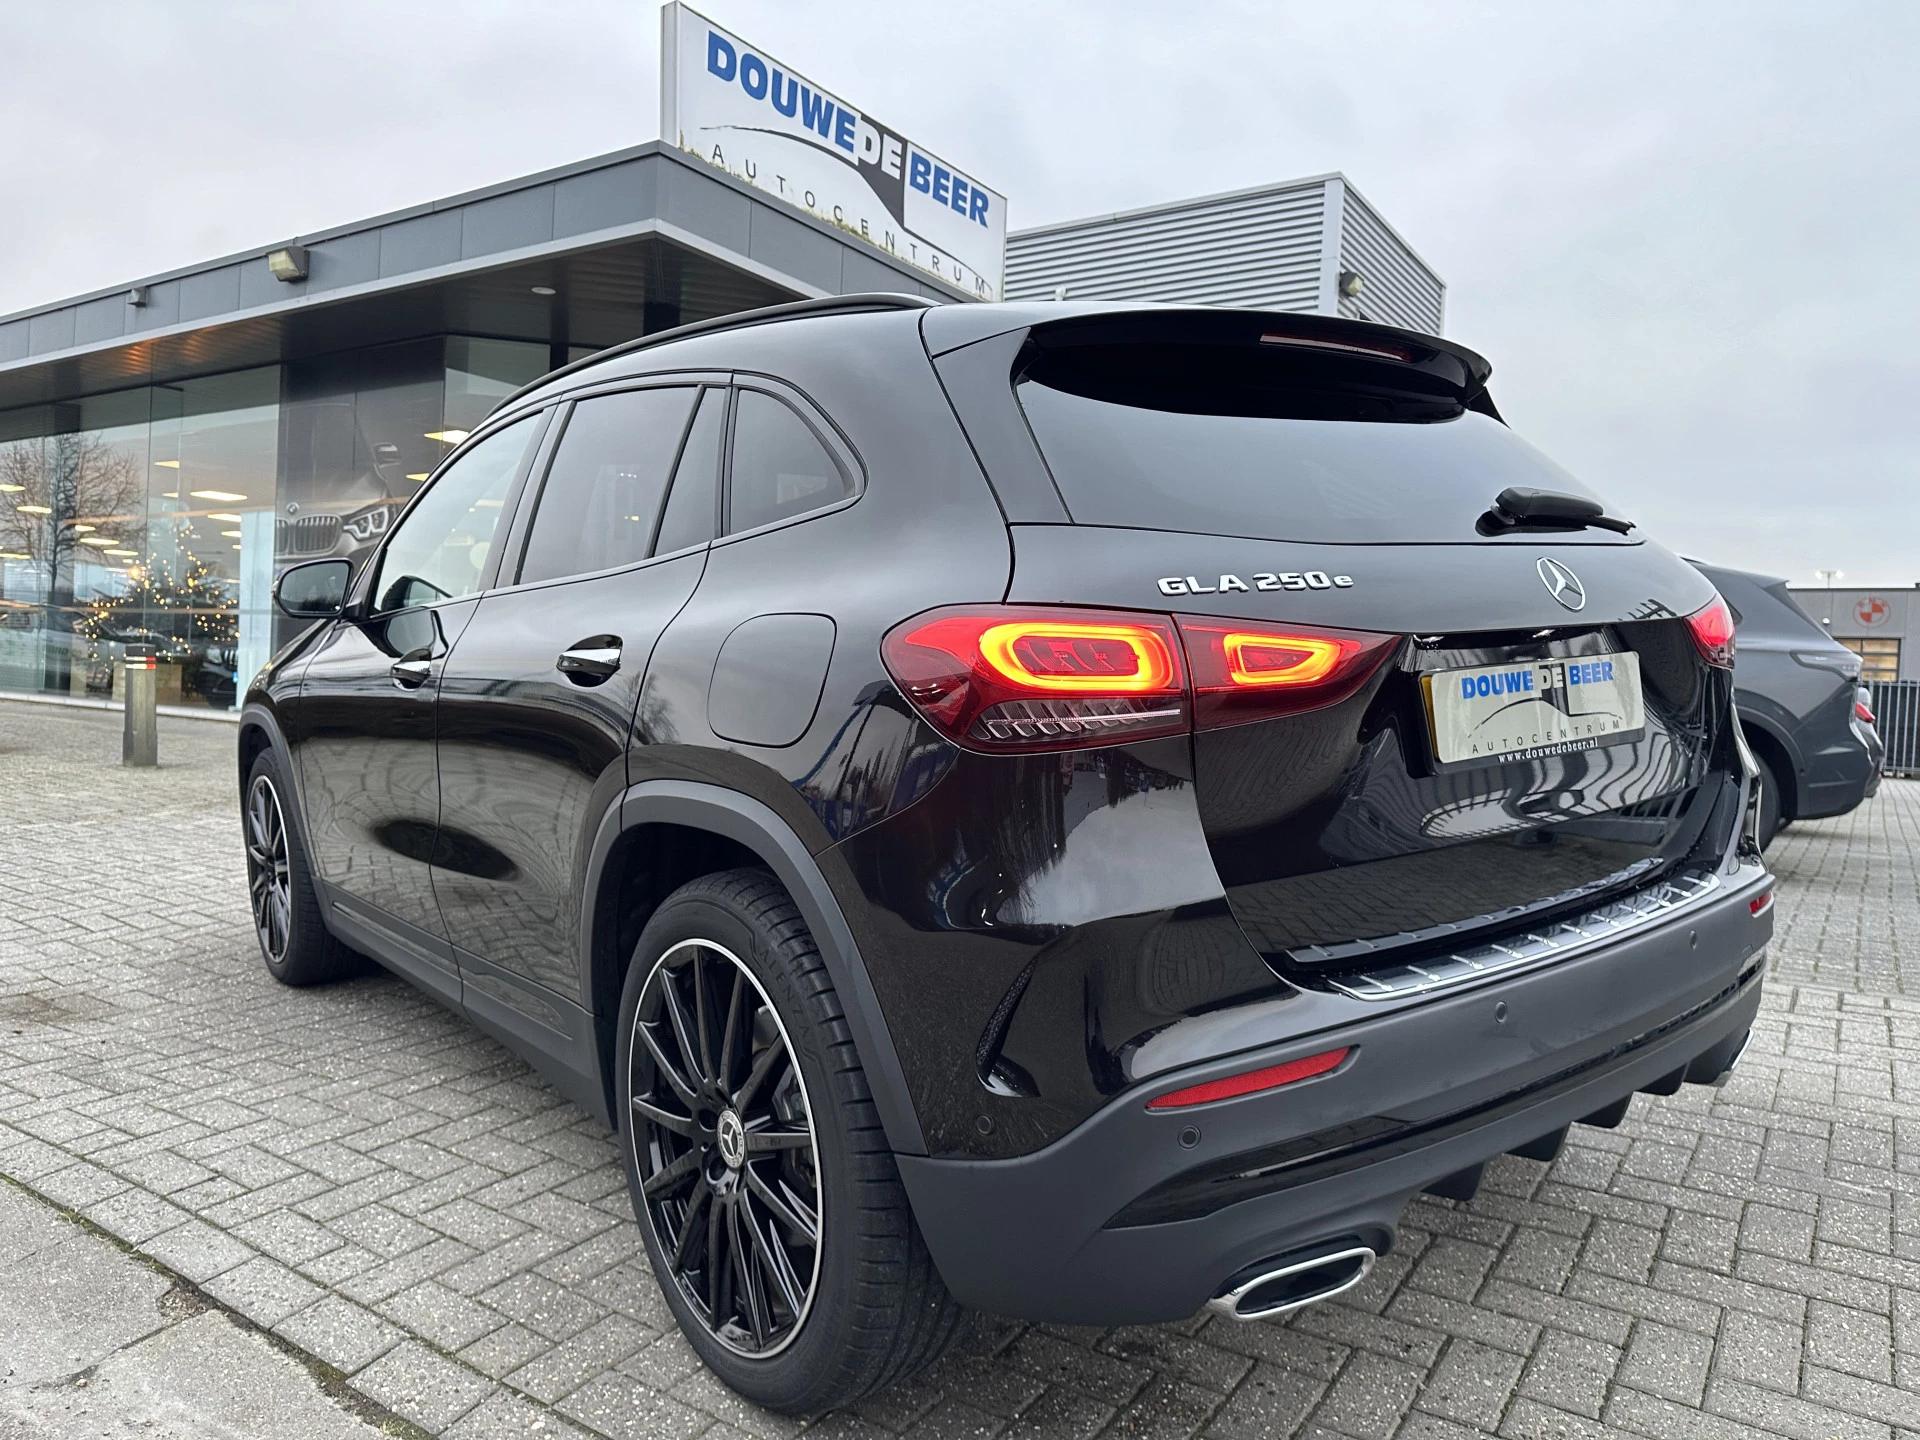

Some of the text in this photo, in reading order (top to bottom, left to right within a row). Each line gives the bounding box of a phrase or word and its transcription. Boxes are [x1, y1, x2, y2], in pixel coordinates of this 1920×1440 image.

[707, 30, 988, 228] DOUWE DE BEER
[712, 144, 986, 295] AUTOCENTRUM
[1157, 571, 1354, 596] GLA 250e
[1461, 662, 1613, 699] DOUWE DE BEER
[1472, 720, 1620, 755] AUTOCENTRUM
[1498, 737, 1599, 764] www.douwedebeer.nl
[761, 950, 809, 1039] ALENZA
